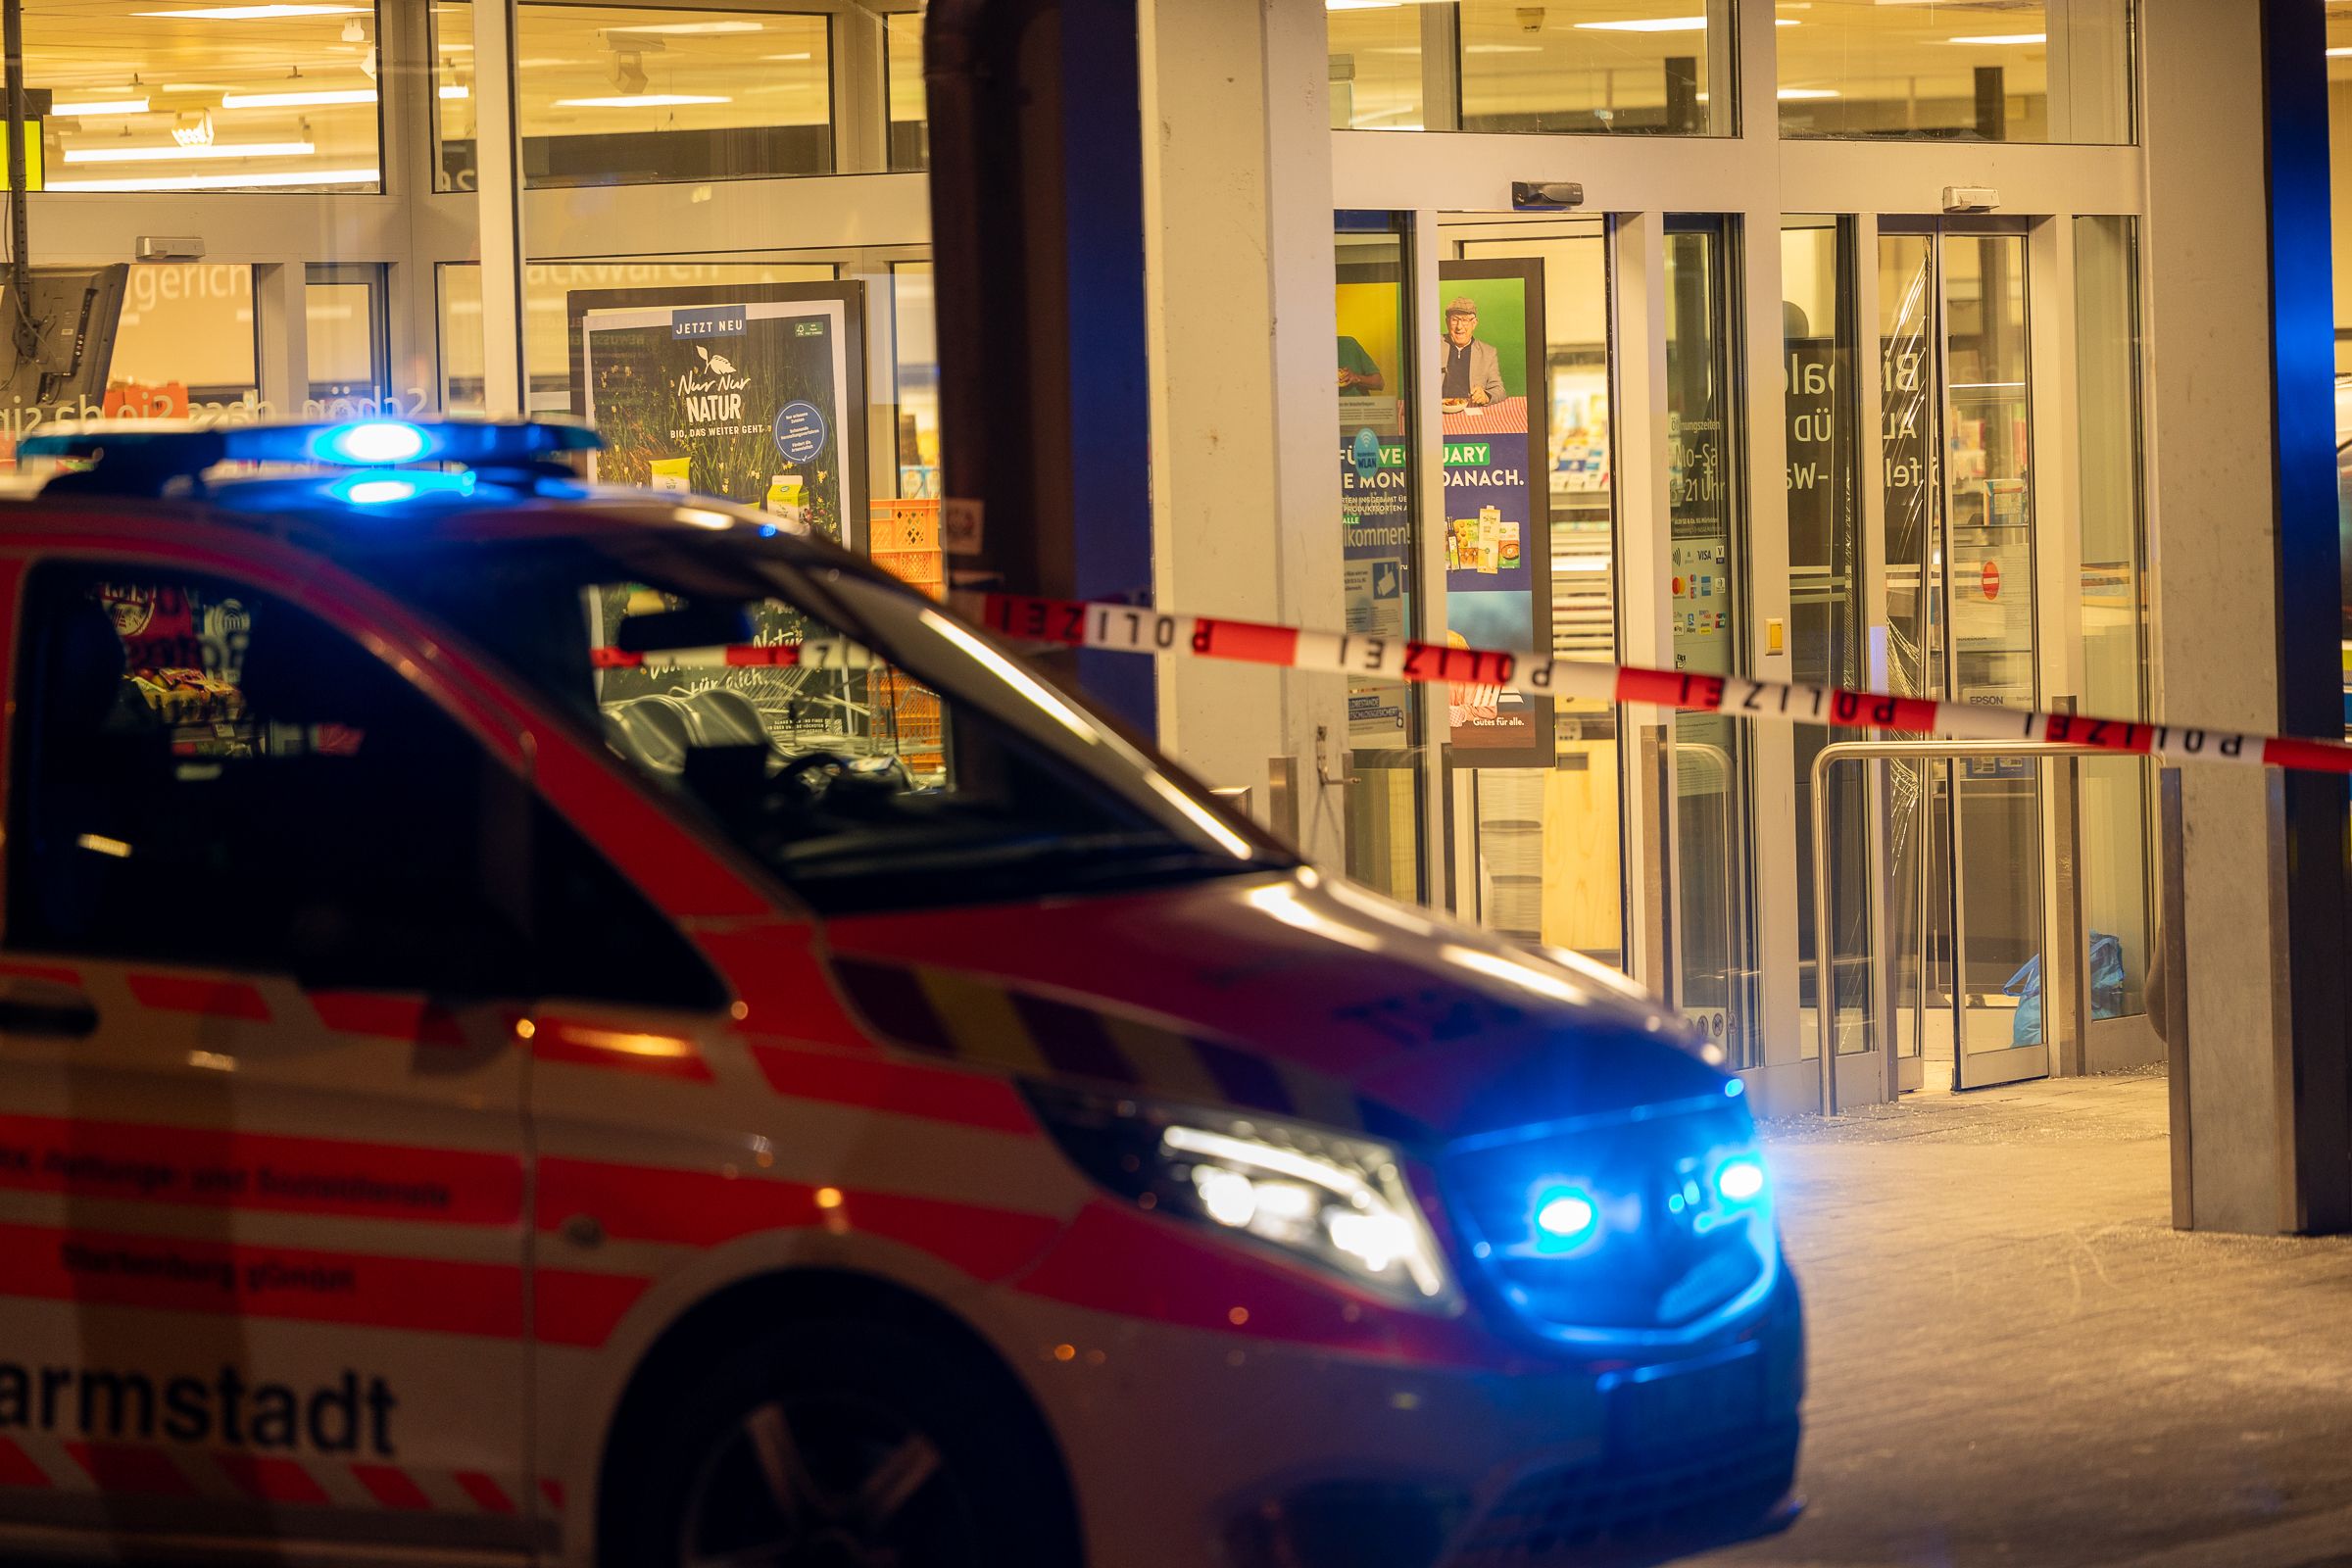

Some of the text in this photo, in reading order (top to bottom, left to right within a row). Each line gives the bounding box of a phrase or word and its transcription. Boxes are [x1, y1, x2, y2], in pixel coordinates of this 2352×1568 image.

[676, 319, 743, 334] JETZT NEU
[678, 370, 751, 396] Nur Nur
[686, 394, 741, 423] NATUR
[670, 430, 687, 440] BIO,
[689, 428, 706, 438] DAS
[709, 425, 739, 437] WEITER
[1357, 458, 1377, 468] WLAN
[1701, 474, 1725, 502] Uhr
[1344, 522, 1411, 548] lkommen!
[1697, 550, 1711, 561] VISA
[1000, 600, 2243, 758] POLIZEI POLIZEI POLIZEI POLIZEI
[1970, 696, 2003, 705] EPSON
[1473, 716, 1525, 726] Gutes für alle.
